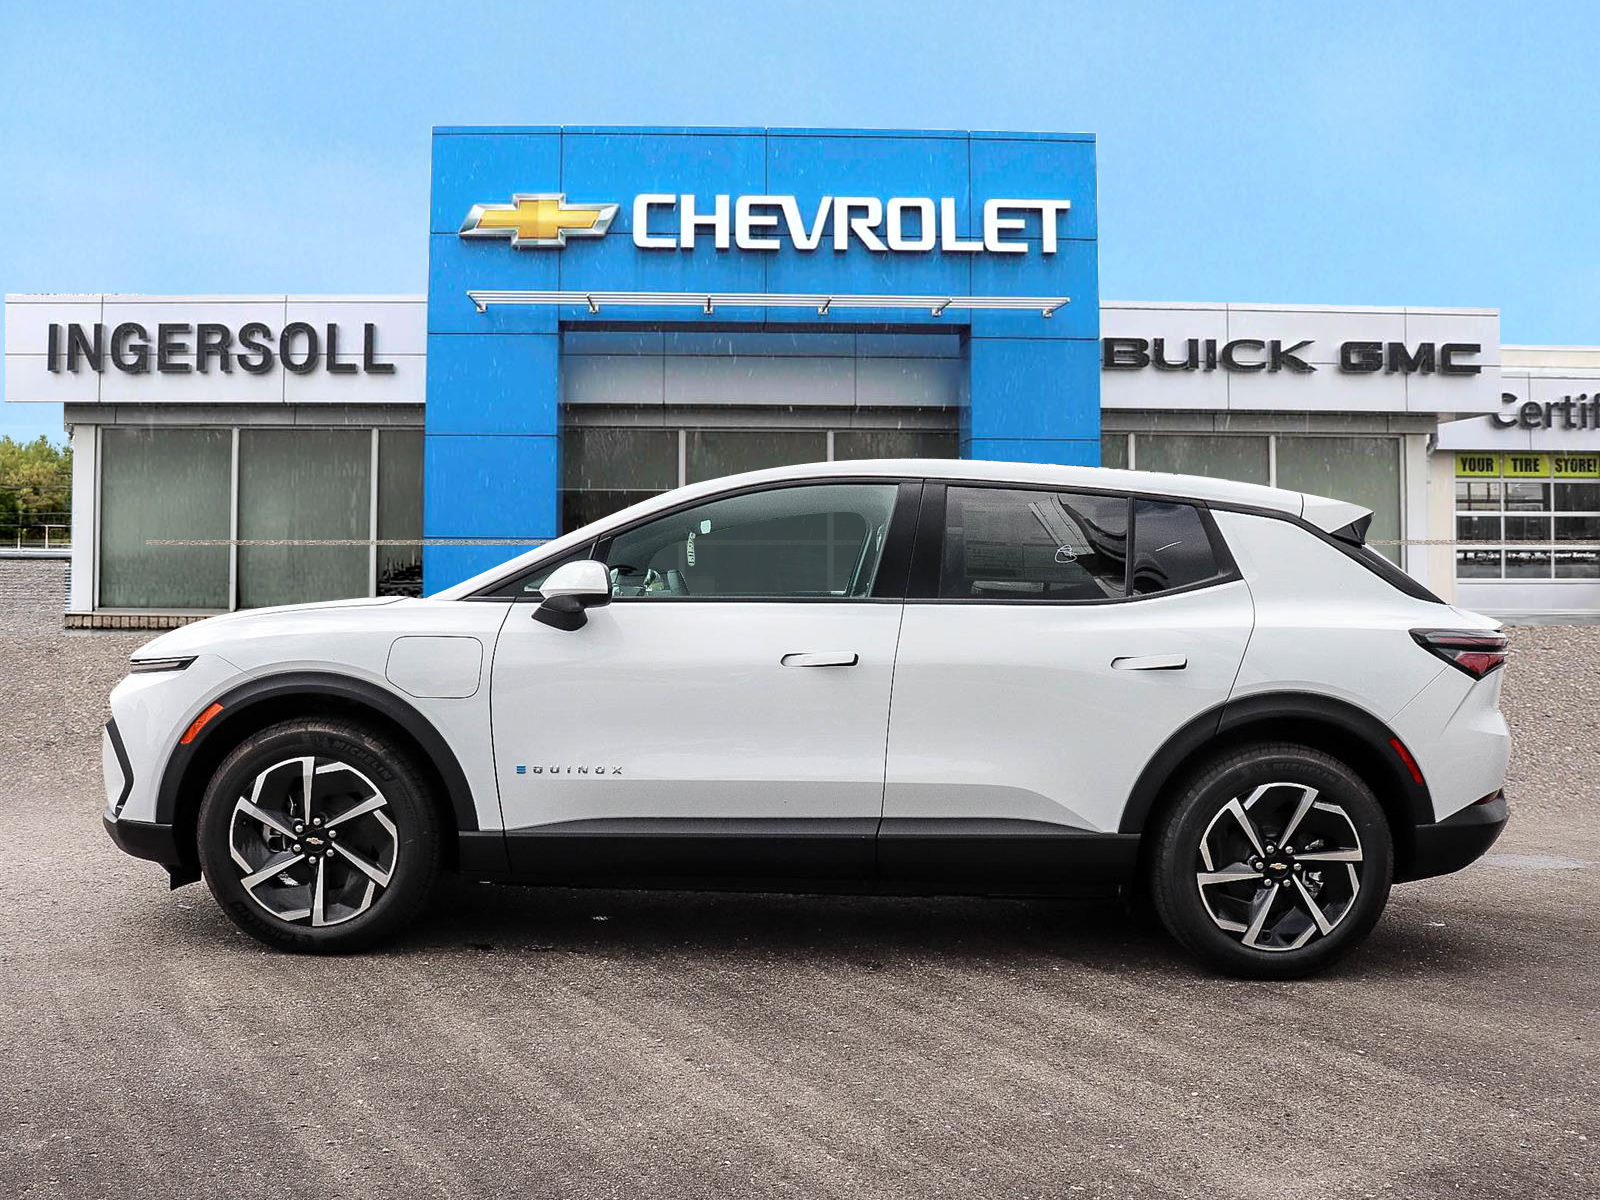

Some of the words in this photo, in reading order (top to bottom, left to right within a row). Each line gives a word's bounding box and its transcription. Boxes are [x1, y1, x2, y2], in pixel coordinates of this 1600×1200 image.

[632, 193, 1071, 254] CHEVROLET
[47, 321, 395, 374] INGERSOLL
[1102, 337, 1318, 373] BUICK
[1338, 340, 1482, 375] GMC
[1460, 456, 1495, 473] YOUR
[1511, 457, 1541, 473] TIRE
[1554, 457, 1598, 473] STORE!
[516, 765, 623, 775] EQUINOX
